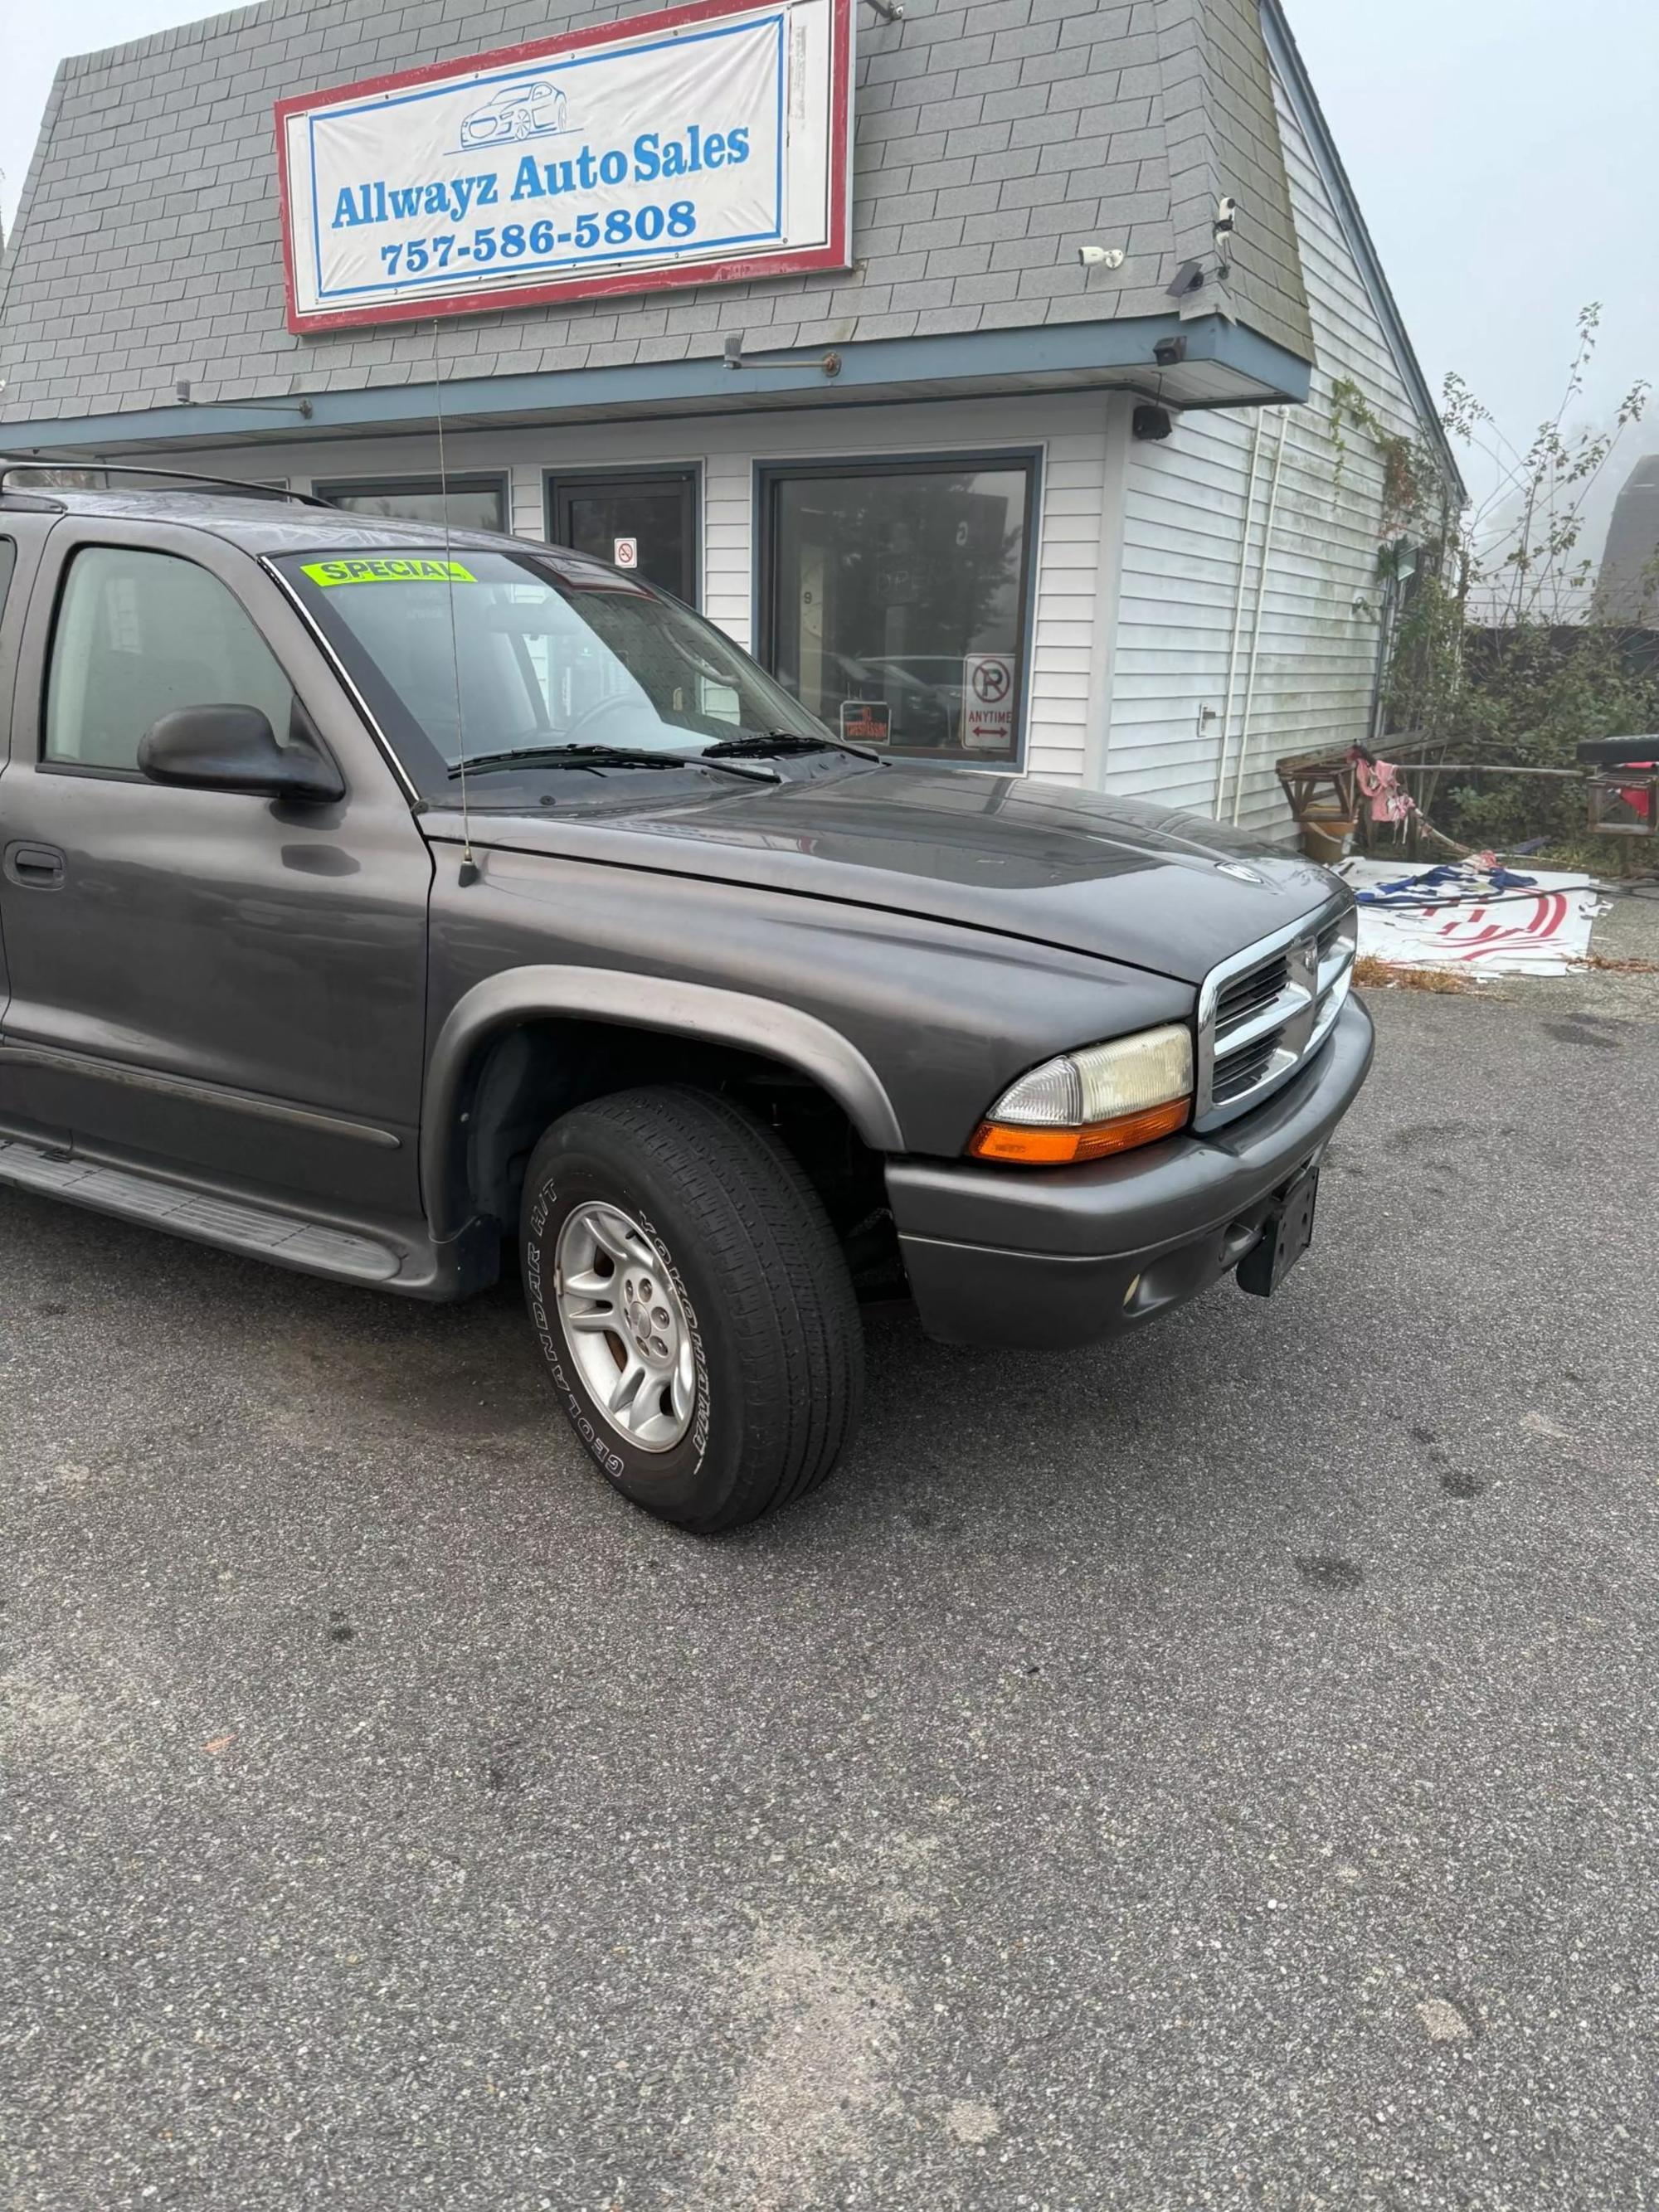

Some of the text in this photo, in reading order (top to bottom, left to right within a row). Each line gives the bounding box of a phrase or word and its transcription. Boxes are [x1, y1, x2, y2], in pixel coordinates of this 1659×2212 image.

[331, 173, 499, 229] Allwayz
[381, 200, 697, 275] 757-586-5808
[320, 561, 465, 580] SPECIAL
[968, 710, 1013, 724] ANYTIME
[528, 1241, 625, 1478] GEOLANDAR
[638, 1209, 711, 1472] YOKOHAMA
